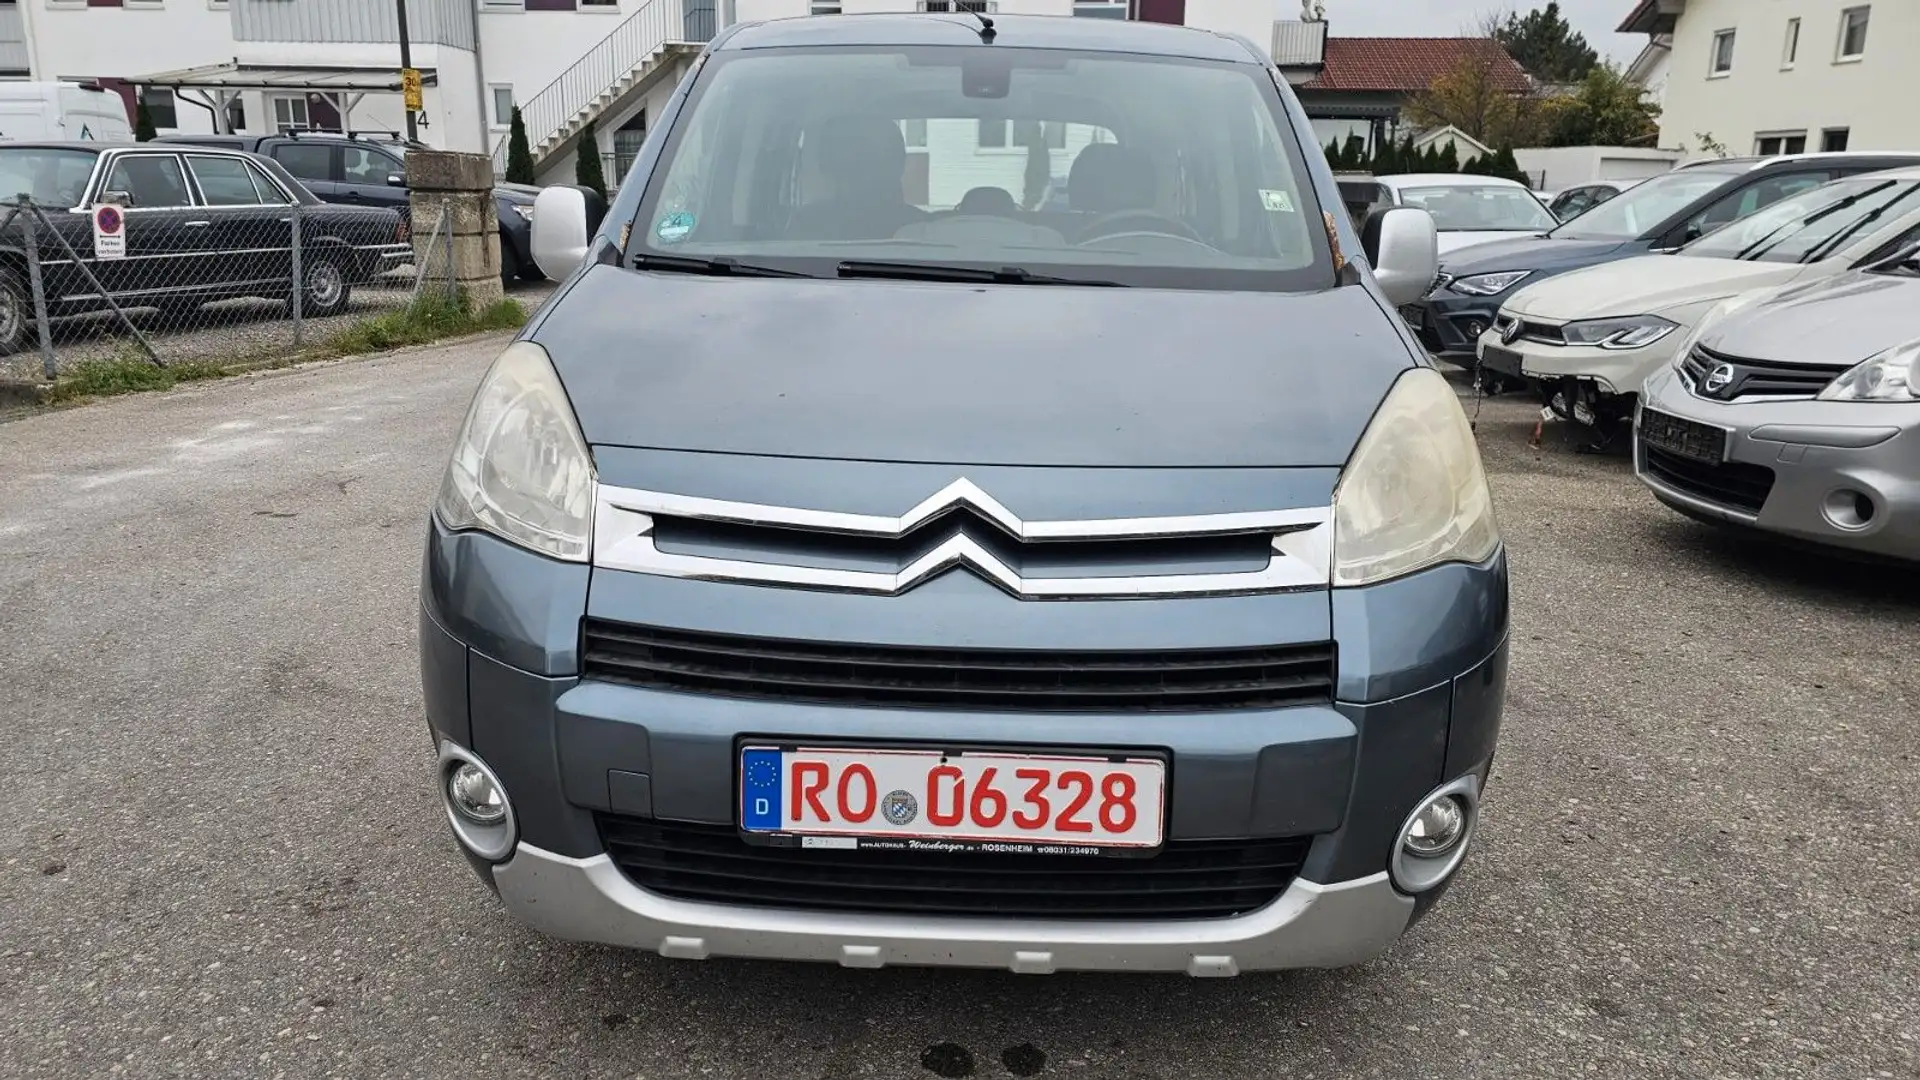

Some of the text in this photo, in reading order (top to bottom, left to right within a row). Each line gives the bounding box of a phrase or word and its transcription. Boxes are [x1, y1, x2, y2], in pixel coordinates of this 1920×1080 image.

[417, 110, 430, 130] 4
[671, 215, 682, 228] 4
[755, 798, 769, 815] D
[791, 762, 878, 824] RO
[926, 765, 1137, 834] 06328
[981, 843, 1033, 853] ROSENHEIM
